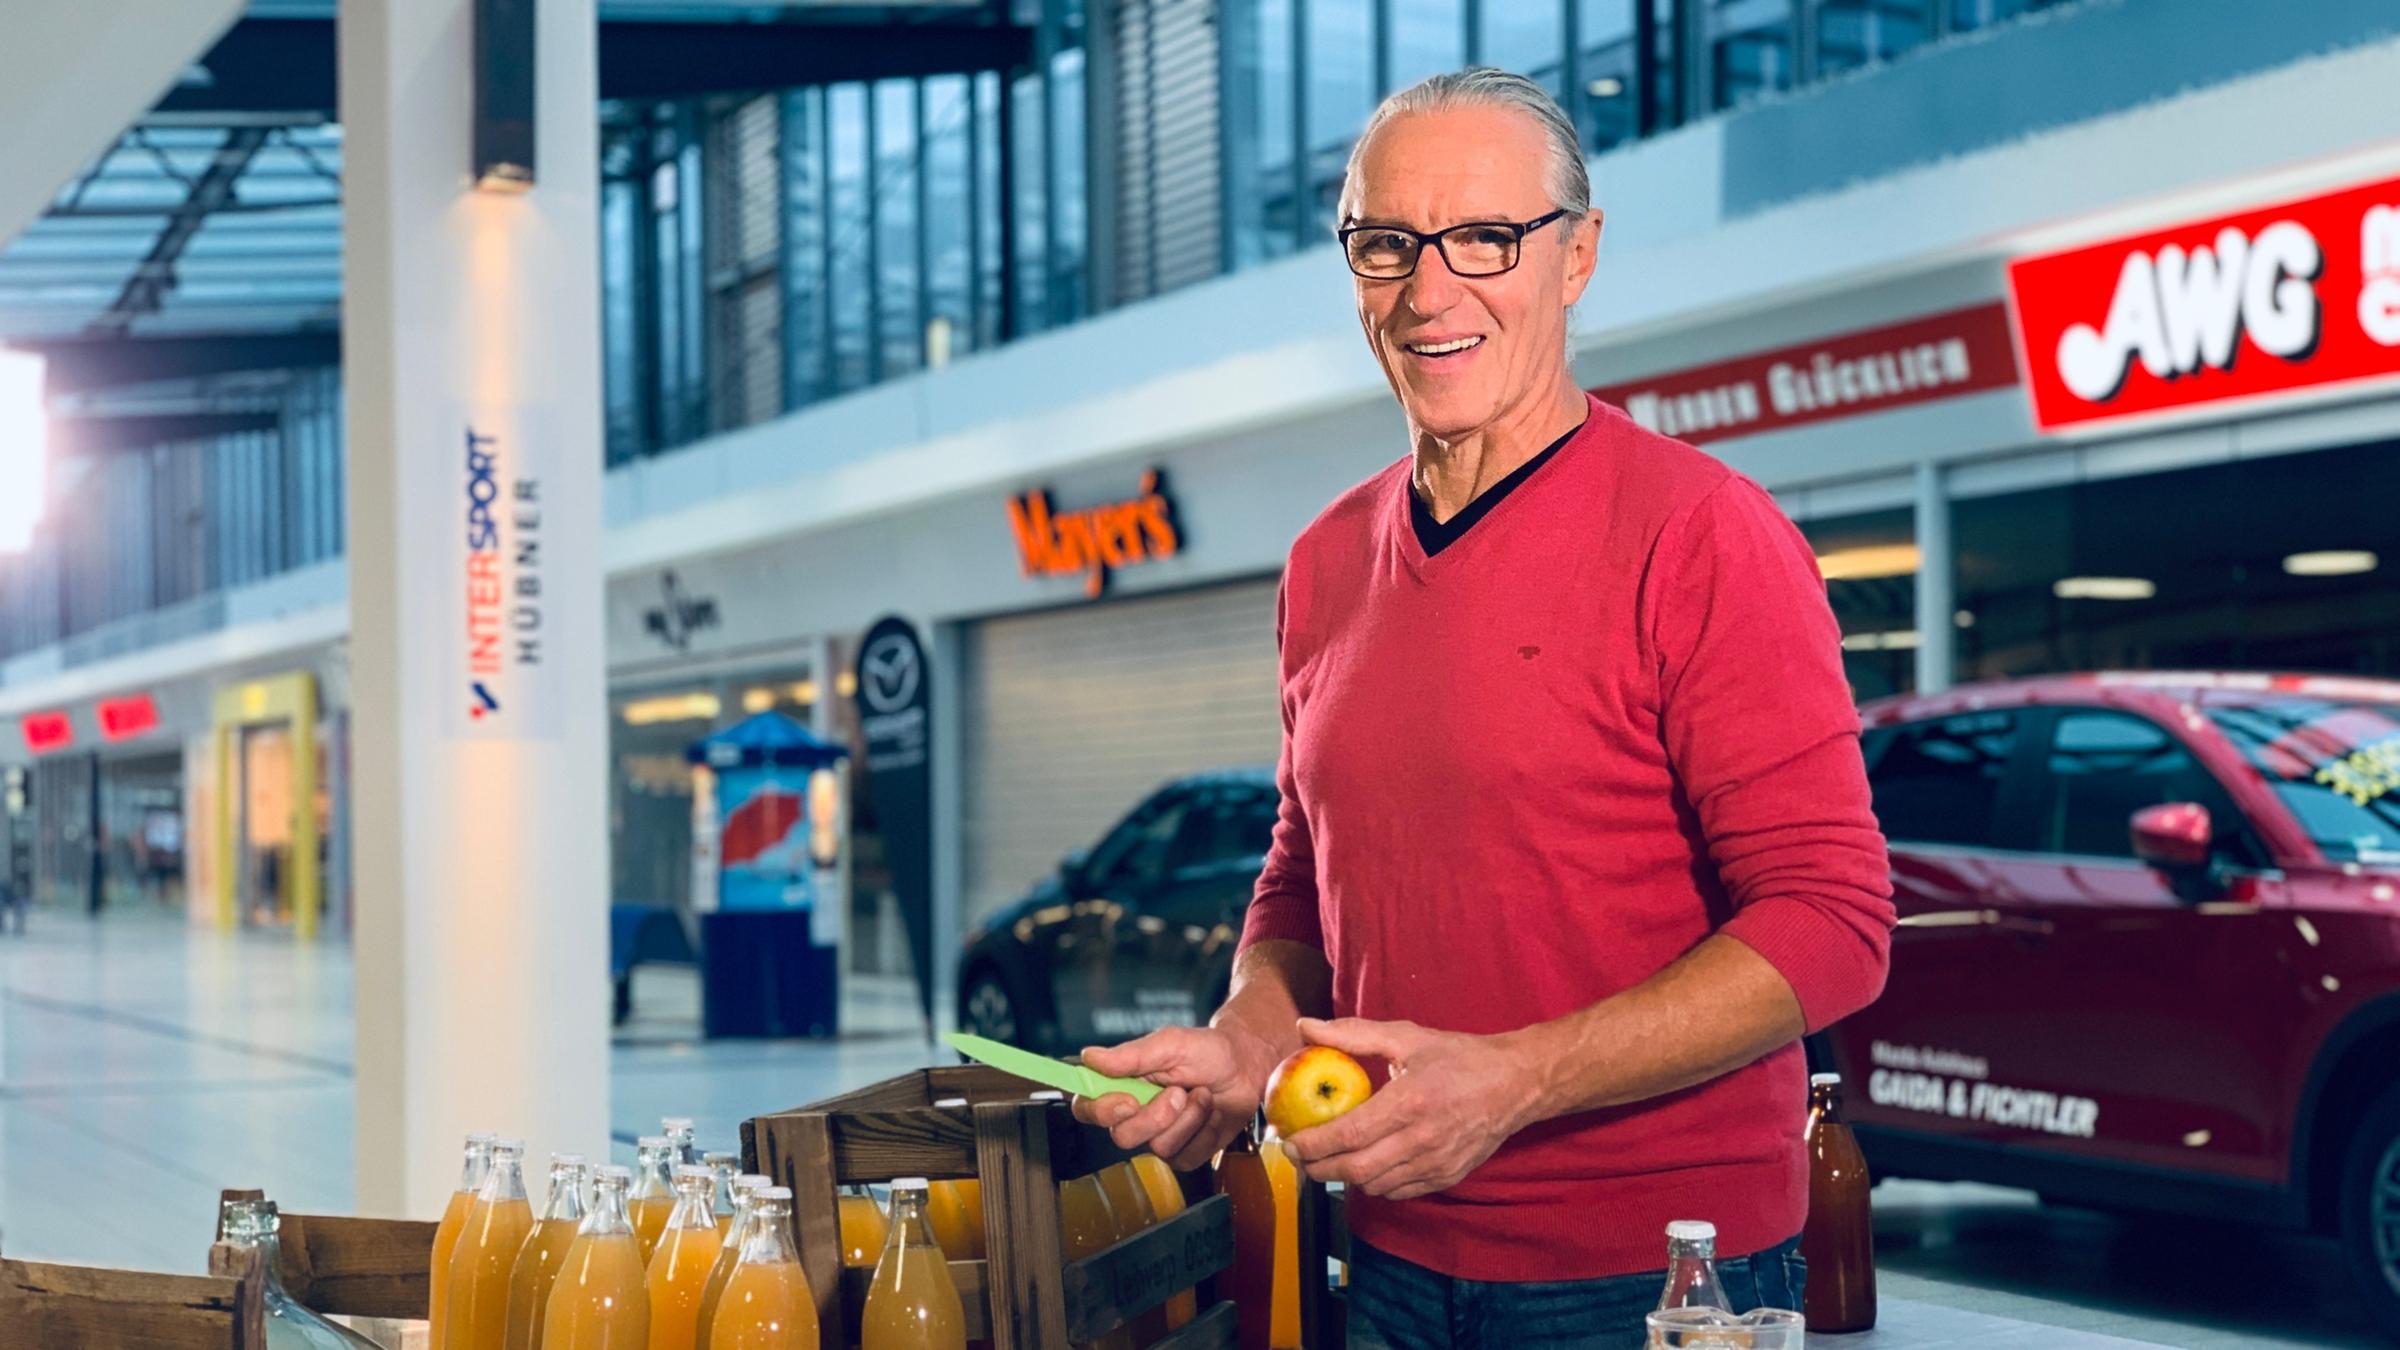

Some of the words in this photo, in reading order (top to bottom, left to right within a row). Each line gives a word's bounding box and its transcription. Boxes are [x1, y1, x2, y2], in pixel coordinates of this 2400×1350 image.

[2056, 219, 2322, 403] AWG
[467, 427, 501, 674] INTERSPORT
[512, 478, 541, 665] HÜBNER
[1868, 1069, 1945, 1114] GAIDA
[1947, 1079, 1967, 1117] &
[1970, 1083, 2098, 1138] FICHTLER
